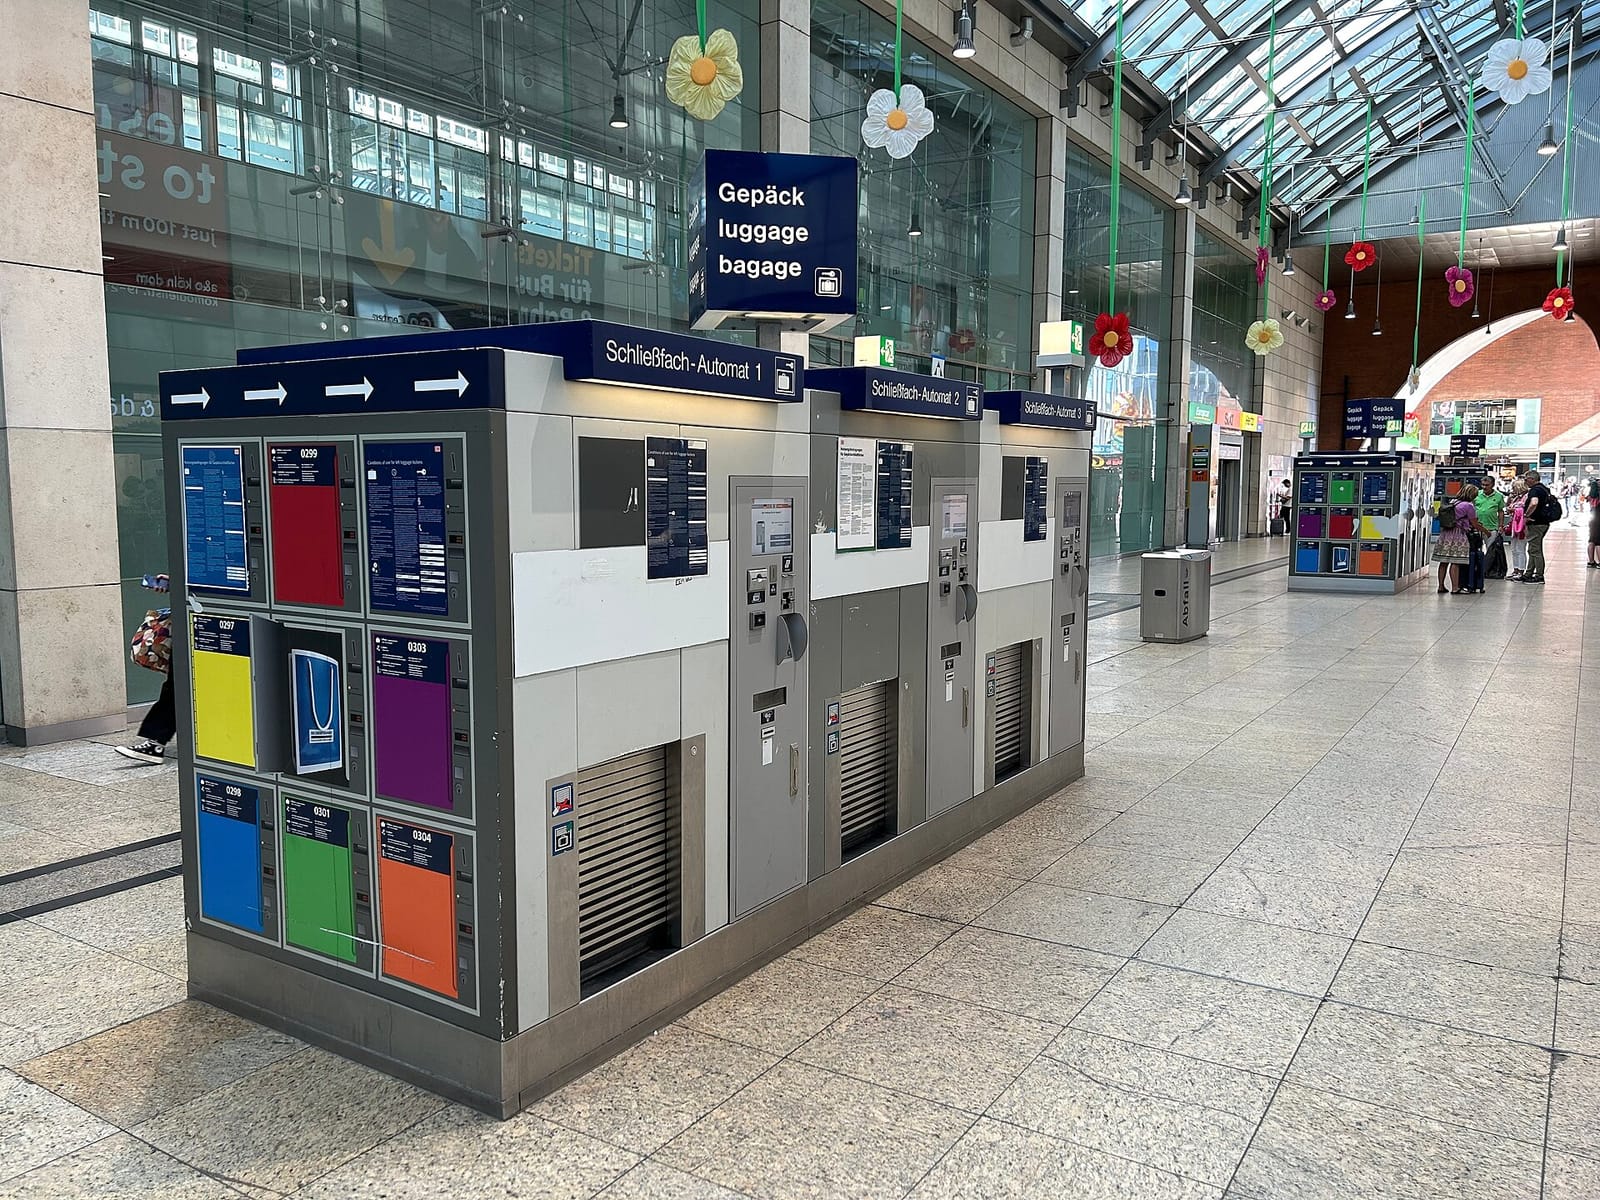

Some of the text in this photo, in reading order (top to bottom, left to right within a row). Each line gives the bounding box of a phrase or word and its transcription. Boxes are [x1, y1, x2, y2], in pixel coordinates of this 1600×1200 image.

[718, 182, 805, 208] Gepäck
[719, 218, 809, 245] luggage
[719, 254, 802, 280] bagage
[606, 339, 762, 382] Schließfach-Automat 1
[871, 379, 960, 406] Schließfach-Automat 2
[1024, 400, 1082, 420] Schließfach-Automat 3
[300, 448, 318, 459] 0299
[219, 620, 235, 630] 0297
[407, 641, 427, 653] 0303
[313, 806, 330, 818] 0301
[412, 829, 432, 843] 0304
